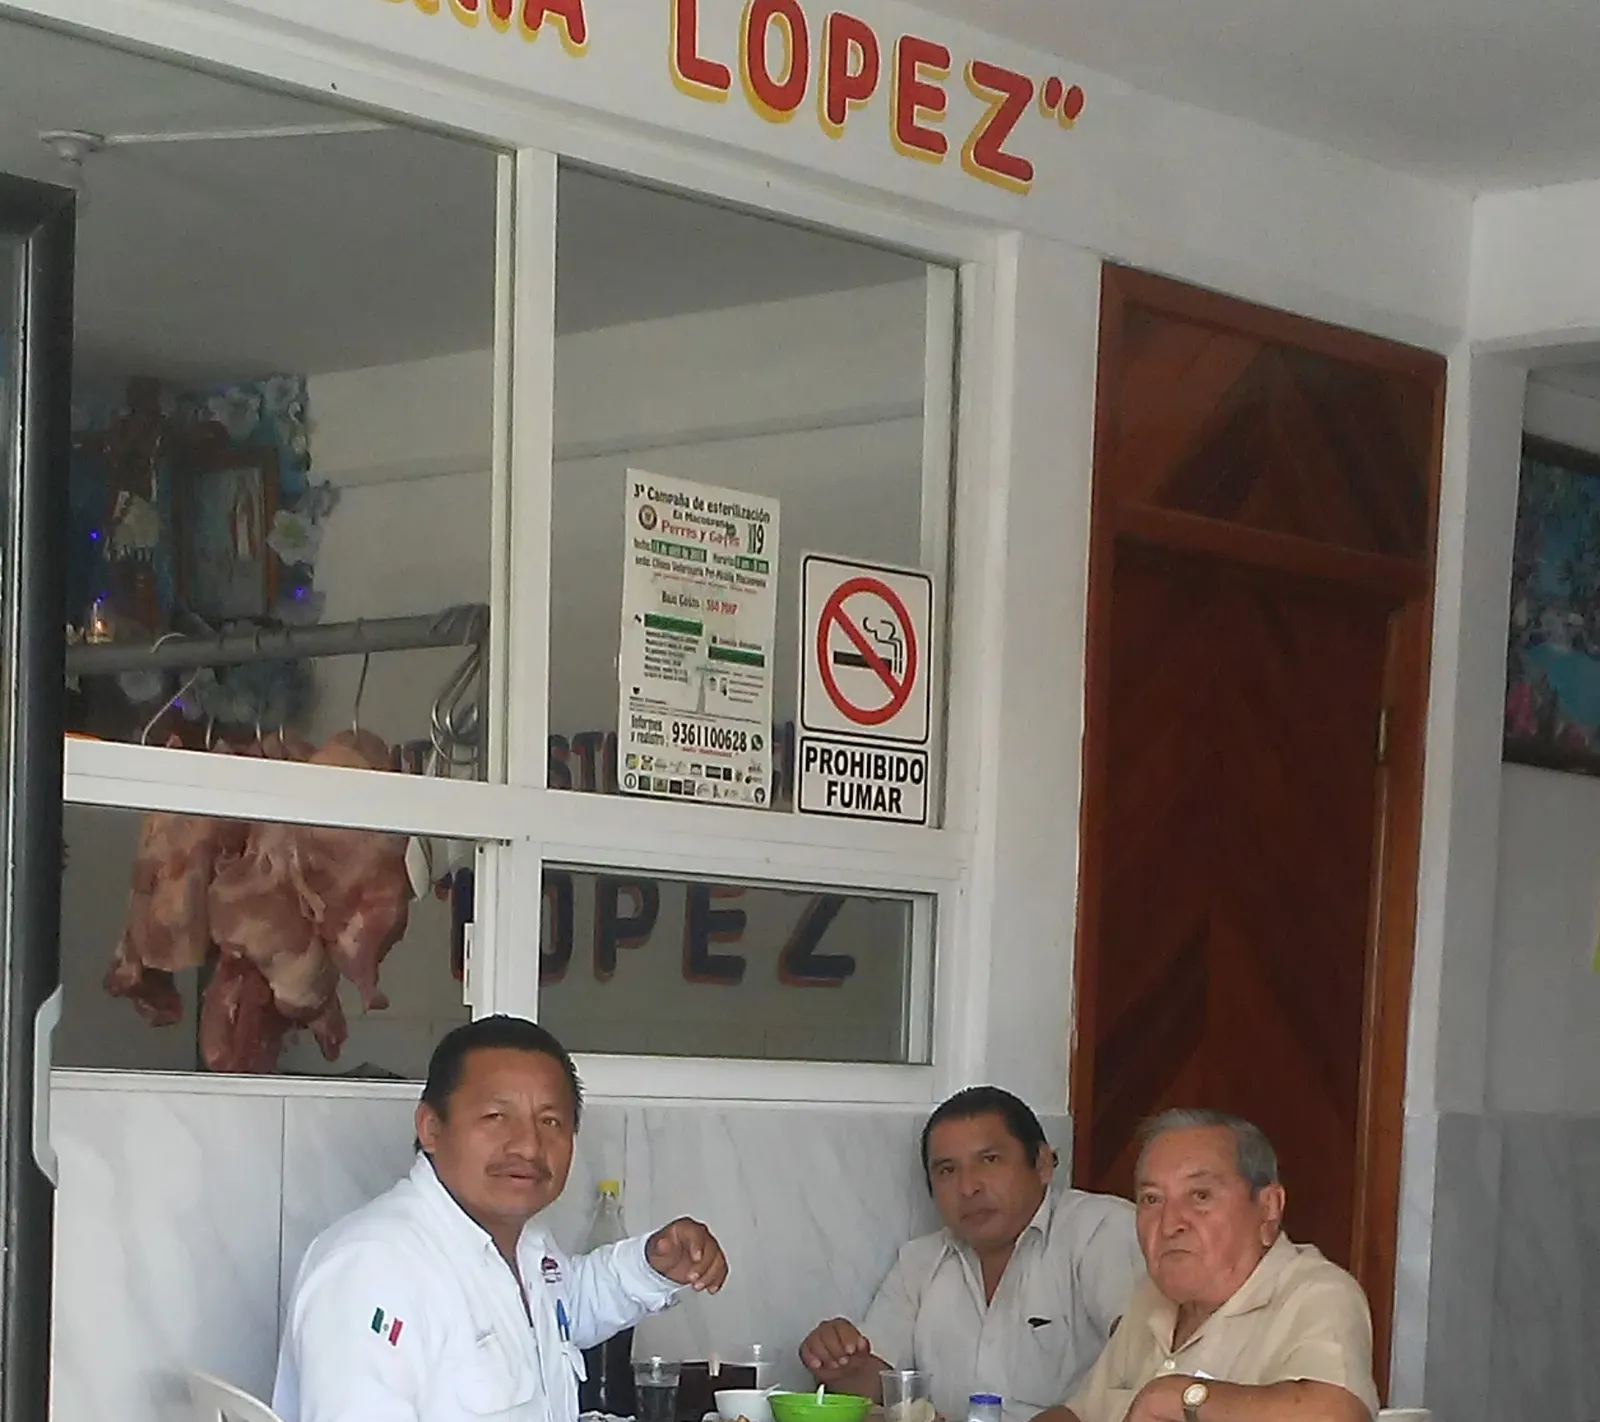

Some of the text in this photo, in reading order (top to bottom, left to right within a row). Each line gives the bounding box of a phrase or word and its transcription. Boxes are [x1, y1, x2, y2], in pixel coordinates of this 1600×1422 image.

[647, 487, 690, 508] Campaña
[693, 496, 704, 511] de
[707, 502, 771, 524] esterilización
[662, 520, 697, 539] Perros
[700, 530, 706, 543] y
[631, 715, 662, 732] Informes
[672, 721, 747, 752] 9361100628
[805, 746, 924, 784] PROHIBIDO
[826, 781, 902, 814] FUMAR
